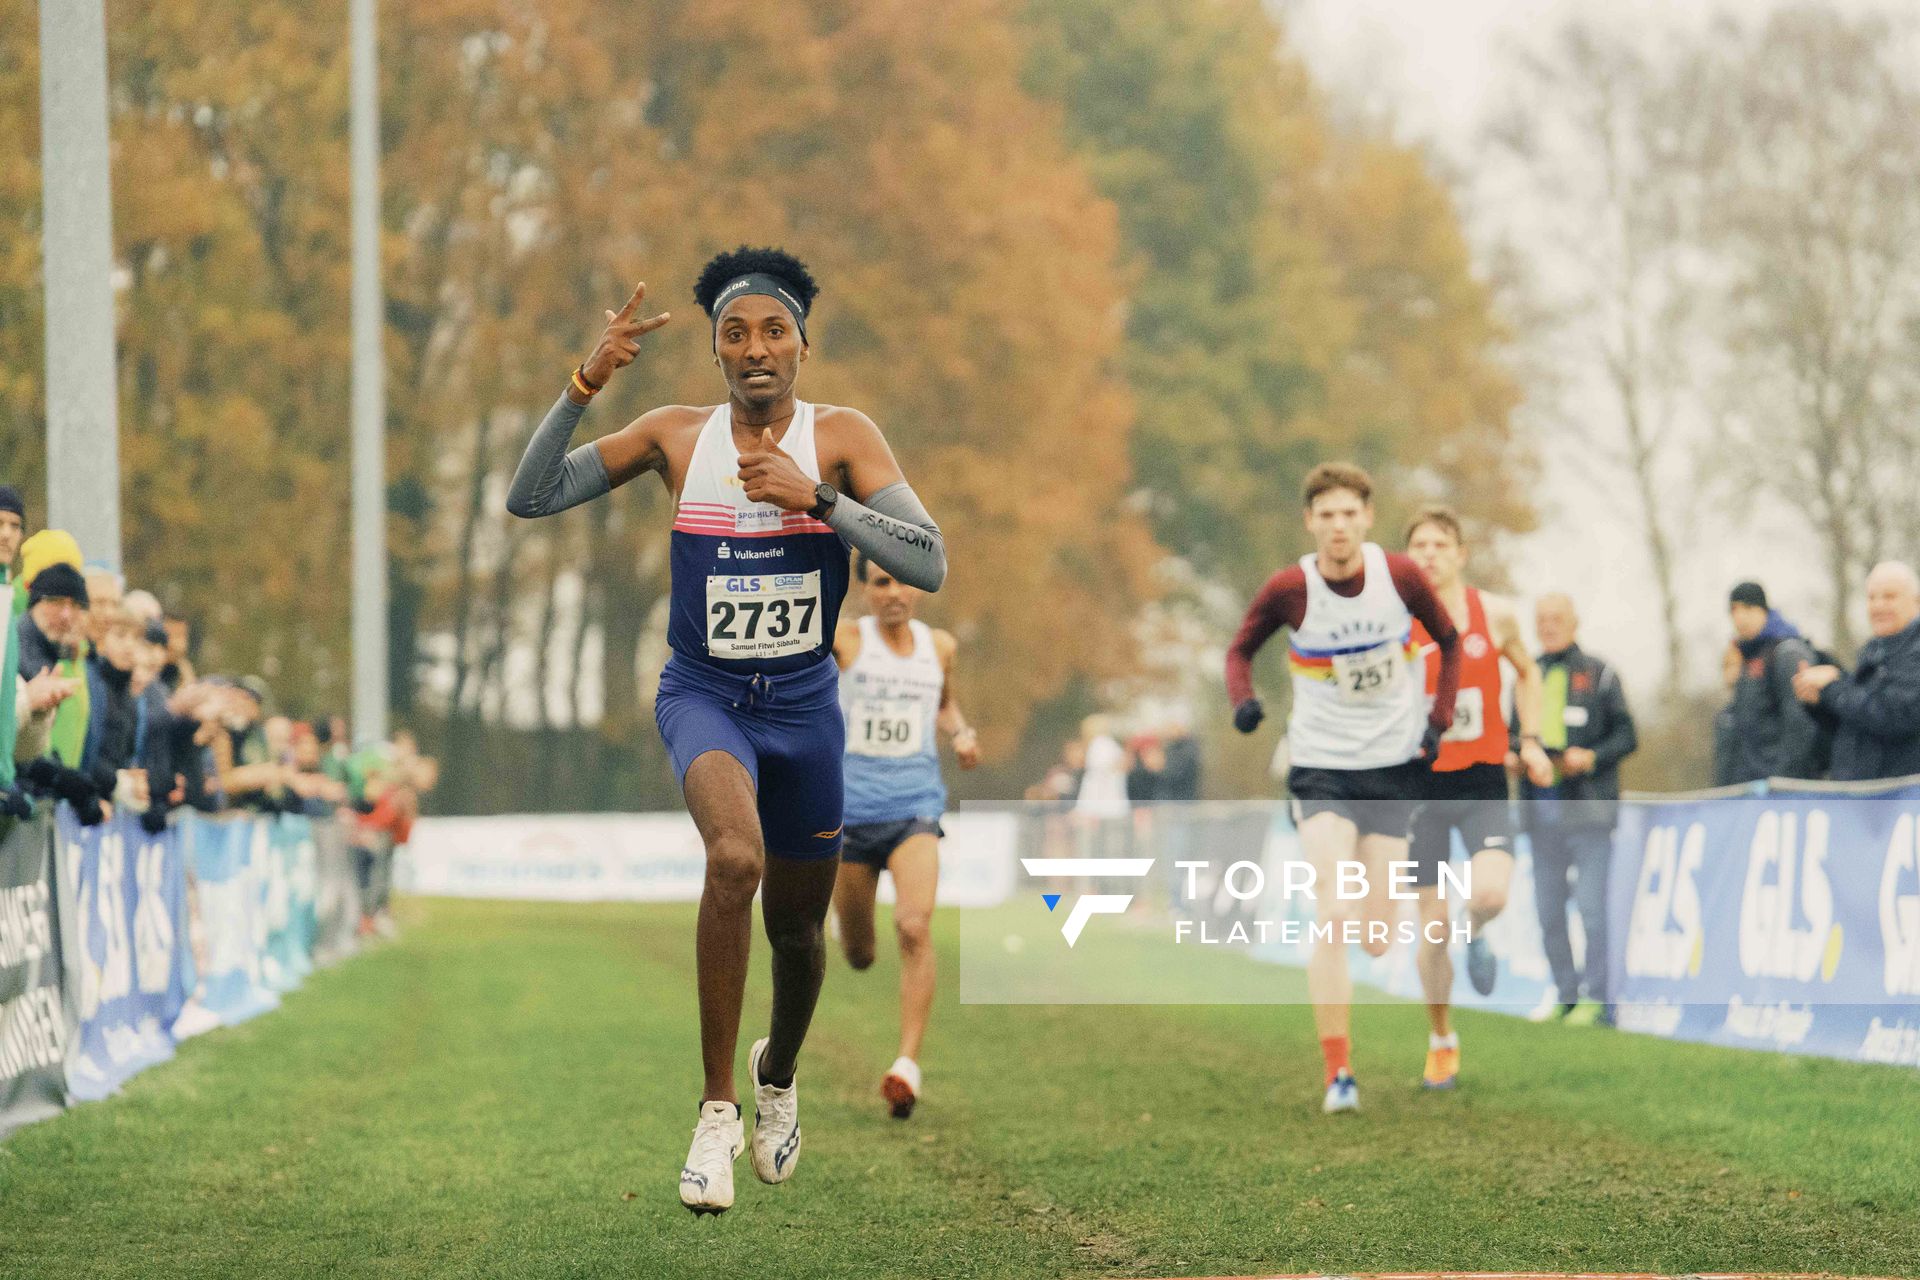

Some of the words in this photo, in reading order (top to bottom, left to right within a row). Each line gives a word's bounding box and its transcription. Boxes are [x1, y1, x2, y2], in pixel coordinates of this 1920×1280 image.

[734, 546, 785, 560] Vulkaneifel
[711, 596, 817, 640] 2737
[730, 642, 757, 651] Samuel
[863, 718, 910, 743] 150
